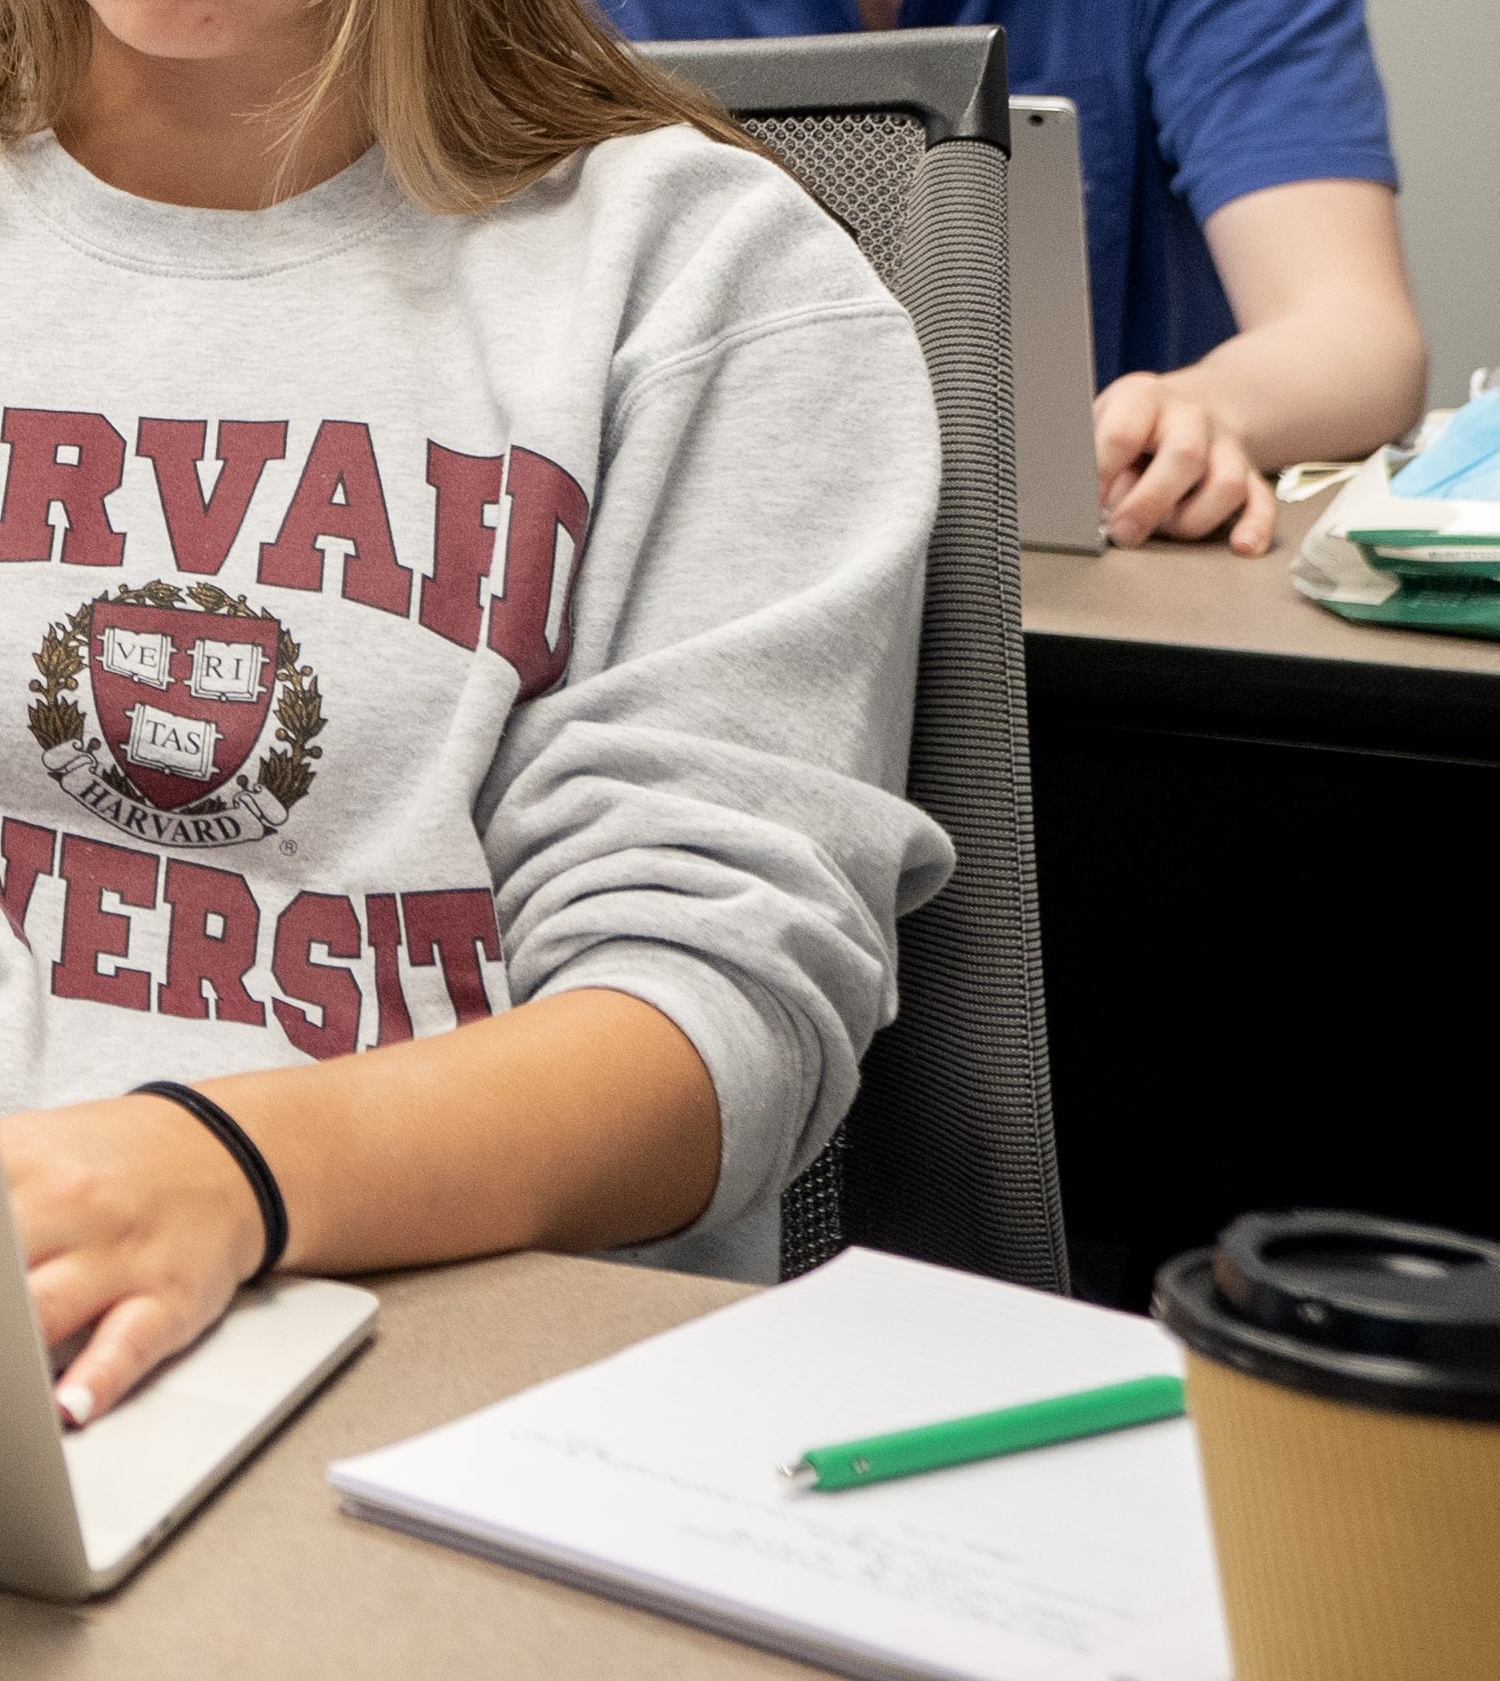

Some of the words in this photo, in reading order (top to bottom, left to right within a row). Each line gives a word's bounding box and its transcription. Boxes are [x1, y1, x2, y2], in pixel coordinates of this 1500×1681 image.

[116, 640, 158, 668] VE
[204, 654, 244, 681] RI
[145, 719, 202, 756] TAS
[80, 780, 242, 844] HARVARD
